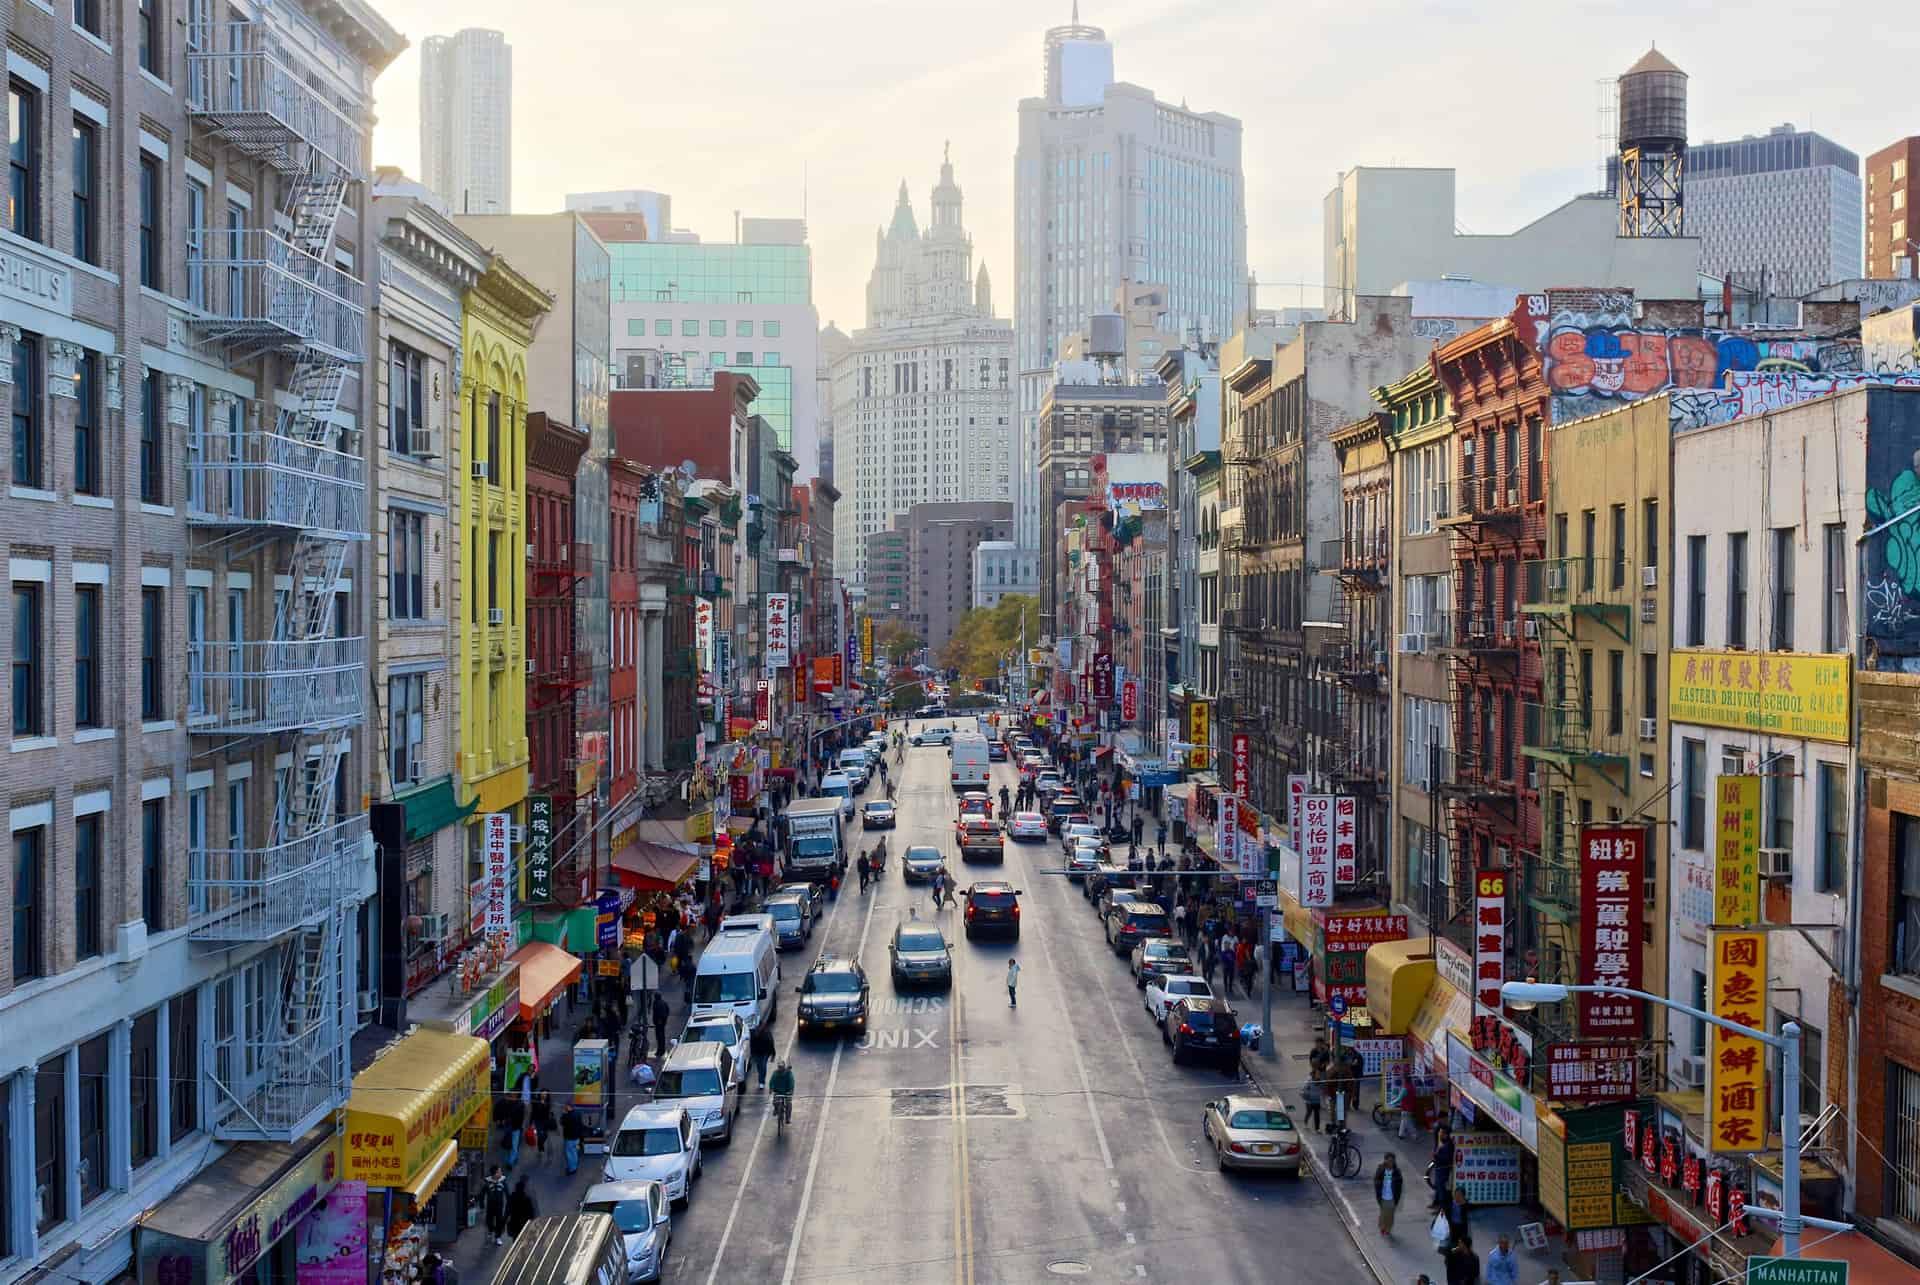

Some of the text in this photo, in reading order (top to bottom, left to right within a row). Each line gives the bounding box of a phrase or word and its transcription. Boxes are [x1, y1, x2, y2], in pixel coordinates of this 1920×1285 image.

[1679, 687, 1803, 713] EASTERN DRIVING SCHOOL
[1589, 838, 1636, 860] 紐約
[1480, 879, 1503, 895] 66
[1758, 1267, 1838, 1284] MANHATTAN
